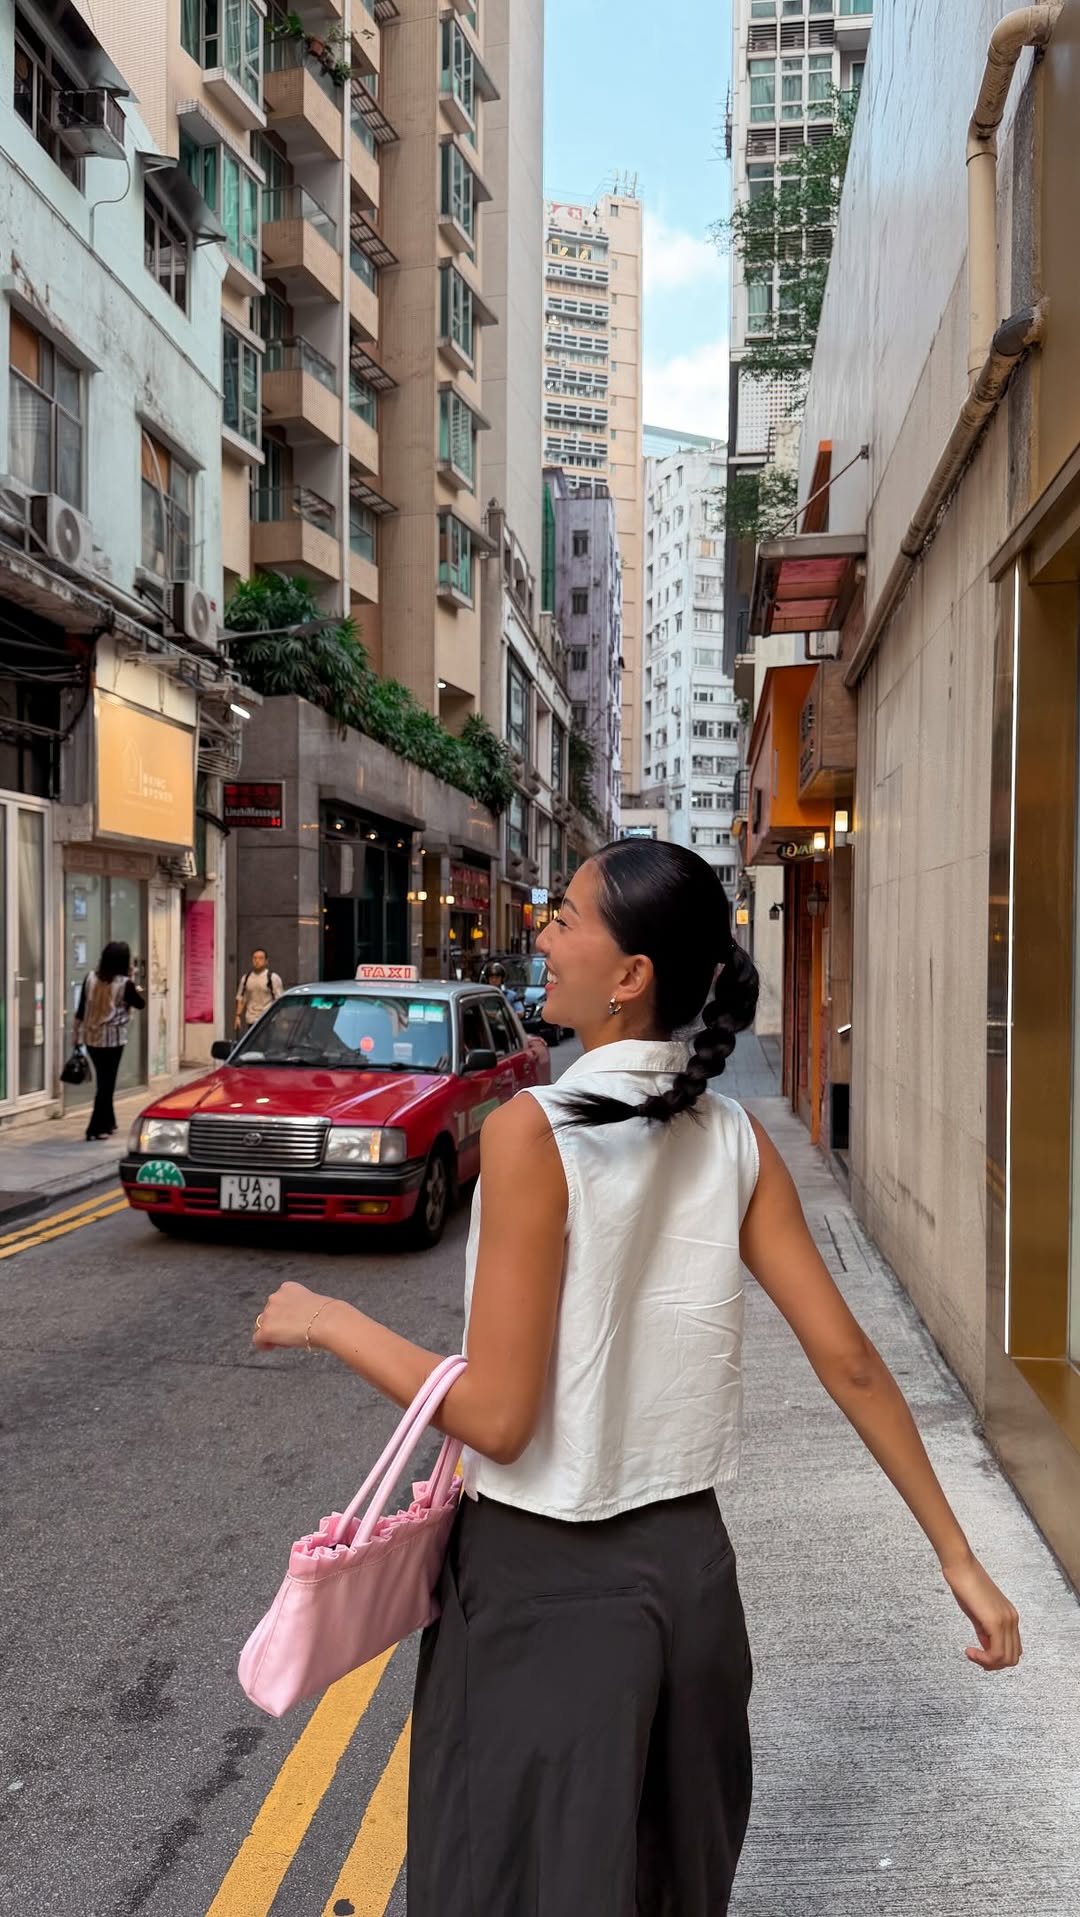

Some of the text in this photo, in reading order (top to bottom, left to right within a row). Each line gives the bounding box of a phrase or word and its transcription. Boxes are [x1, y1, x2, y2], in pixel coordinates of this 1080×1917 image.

[361, 966, 411, 979] TAXI
[147, 1161, 177, 1175] TAXI
[155, 1169, 164, 1177] 4
[143, 1175, 178, 1187] SEATS
[238, 1177, 262, 1193] UA
[228, 1192, 276, 1211] 1340
